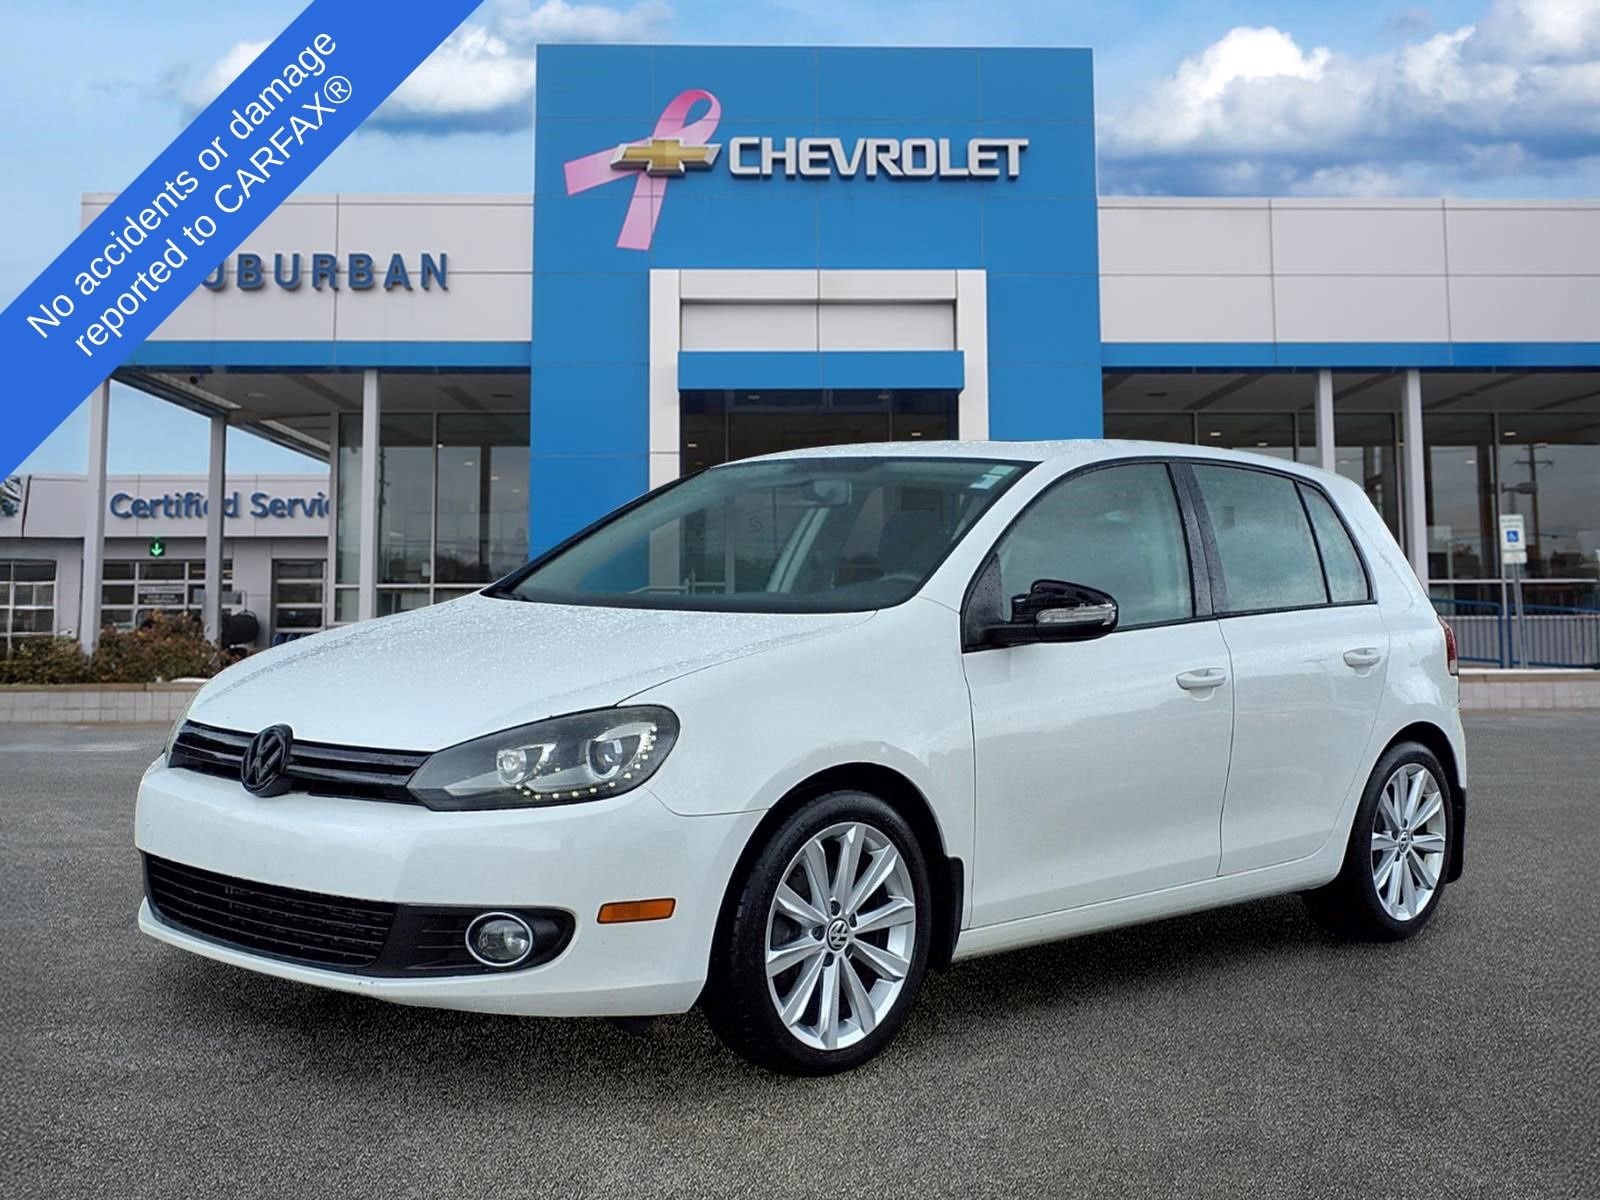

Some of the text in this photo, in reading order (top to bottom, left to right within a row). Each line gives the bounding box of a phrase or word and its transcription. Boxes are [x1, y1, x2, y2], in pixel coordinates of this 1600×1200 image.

[728, 135, 1030, 180] CHEVROLET
[201, 251, 449, 291] UBURBAN
[110, 491, 241, 519] Certifid
